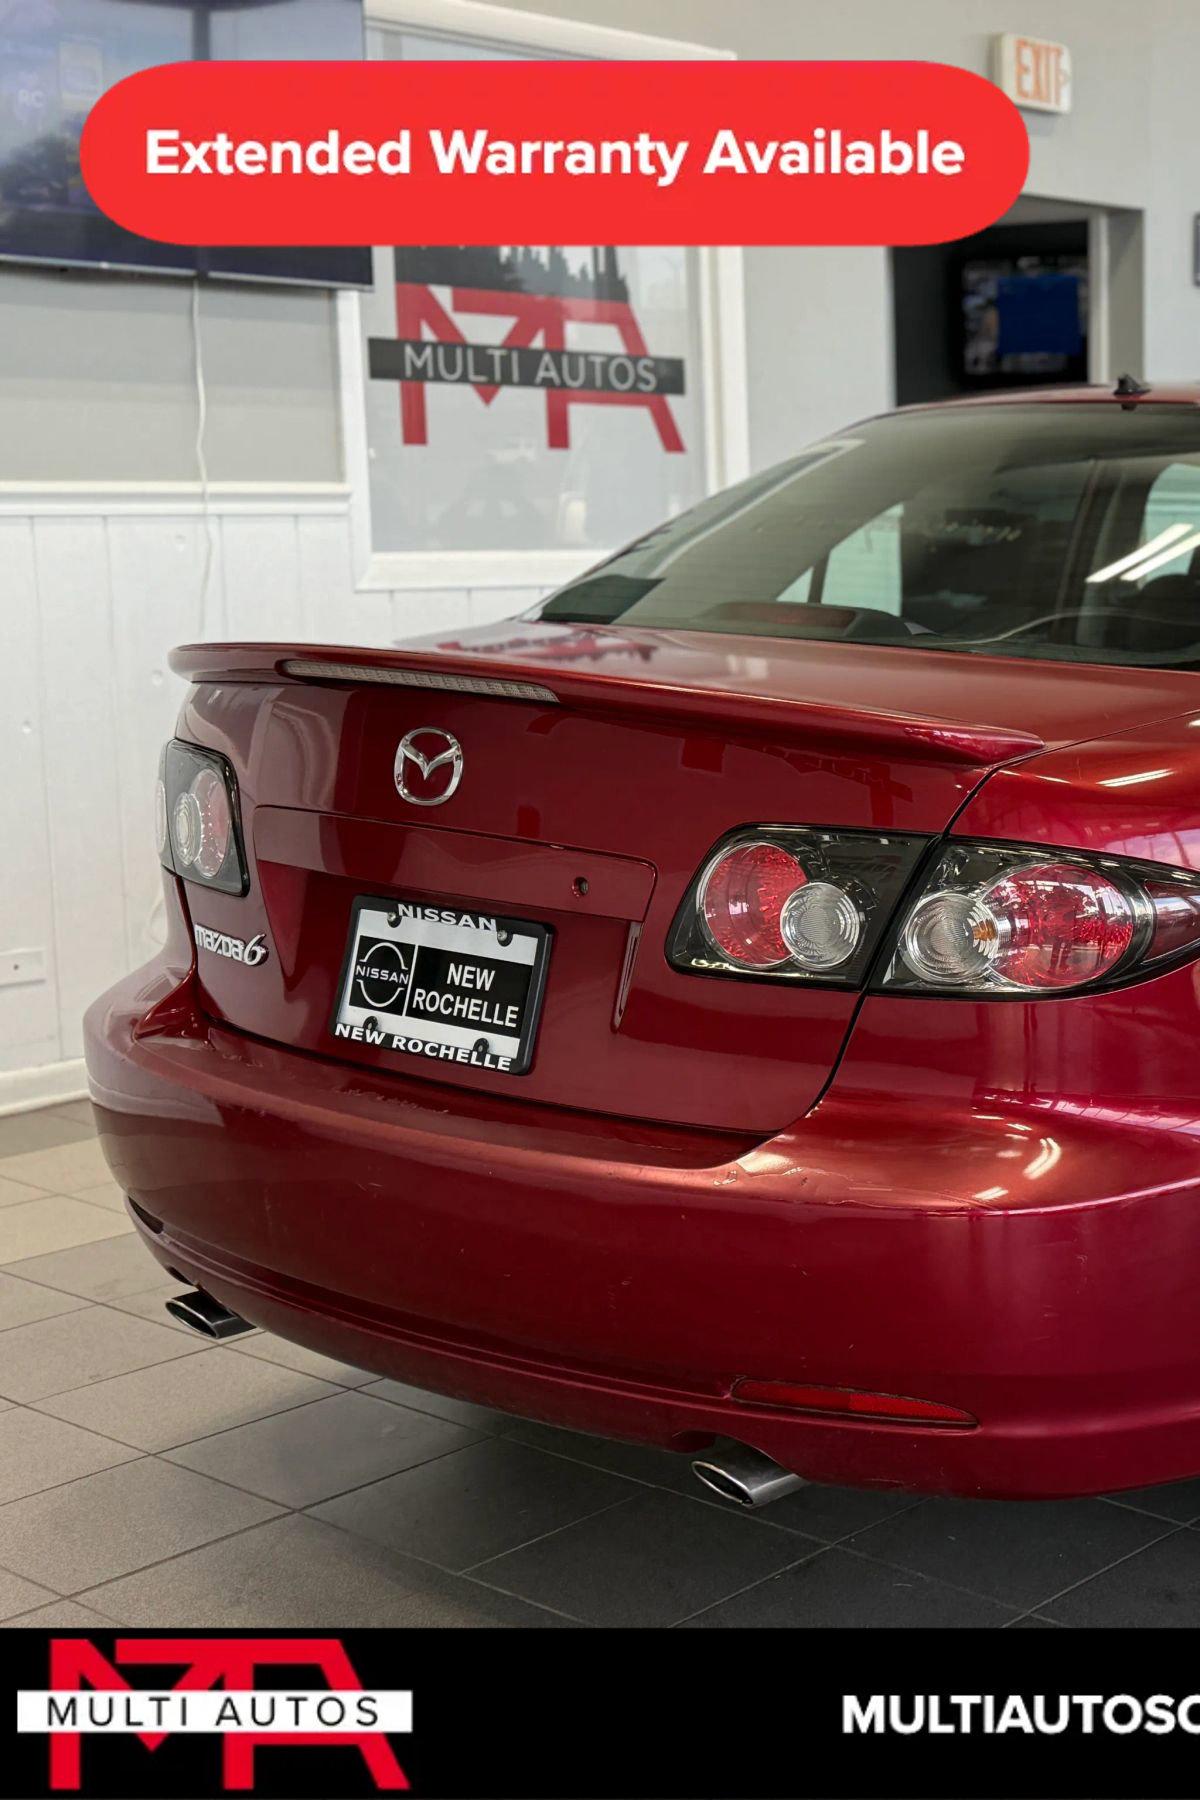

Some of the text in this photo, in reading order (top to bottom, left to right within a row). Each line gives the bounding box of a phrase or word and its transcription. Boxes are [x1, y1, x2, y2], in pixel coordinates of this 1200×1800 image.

[1014, 39, 1064, 104] EXIT
[404, 344, 657, 391] MULTI AUTOS
[397, 903, 498, 932] NISSAN
[355, 965, 409, 985] NISSAN
[447, 963, 496, 992] NEW
[412, 988, 520, 1028] ROCHELLE
[335, 1023, 512, 1072] NEW ROCHELLE
